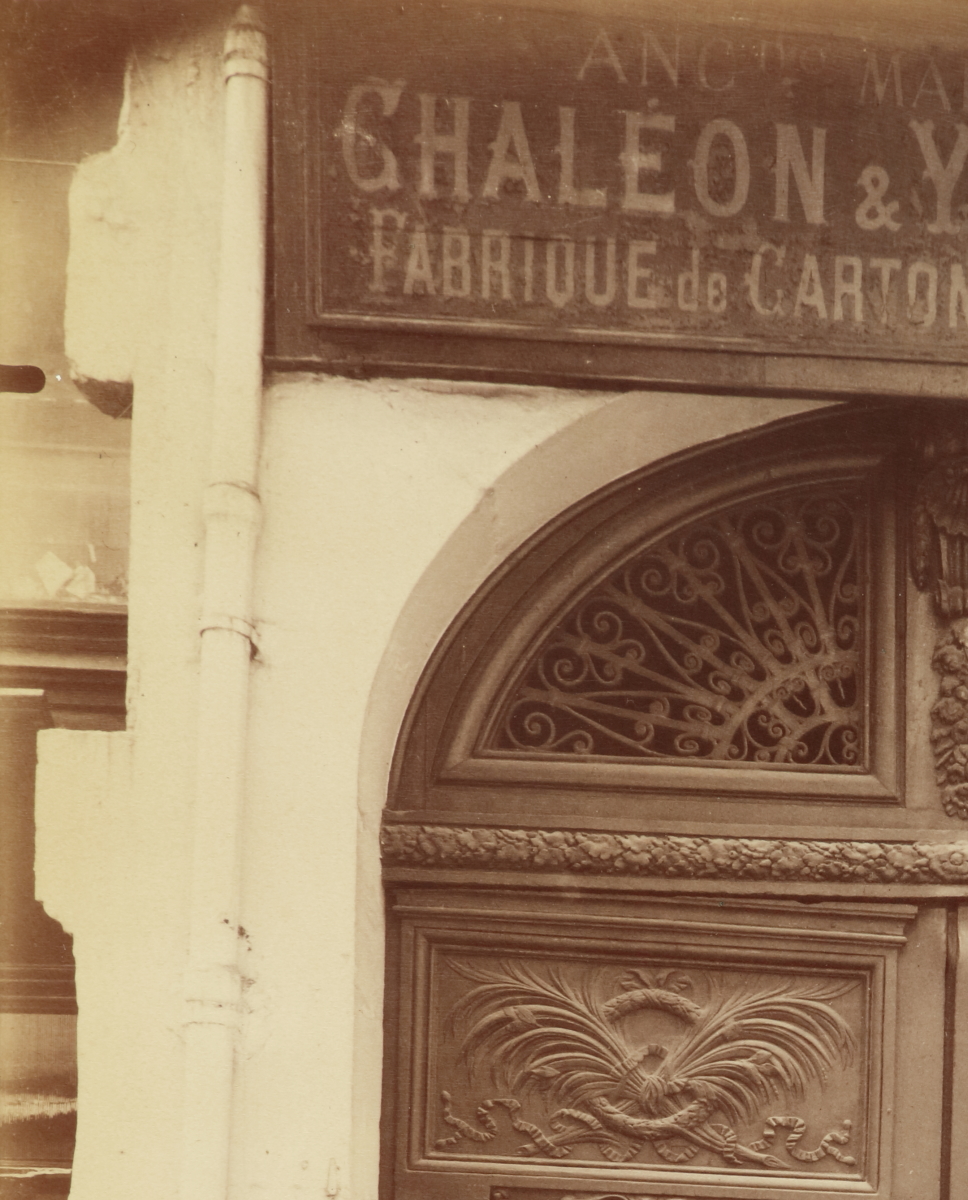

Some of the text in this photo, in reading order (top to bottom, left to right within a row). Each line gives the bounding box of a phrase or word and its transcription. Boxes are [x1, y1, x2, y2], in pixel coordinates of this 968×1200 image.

[855, 164, 902, 231] &
[367, 206, 659, 310] FABRIQUE
[677, 247, 727, 313] de
